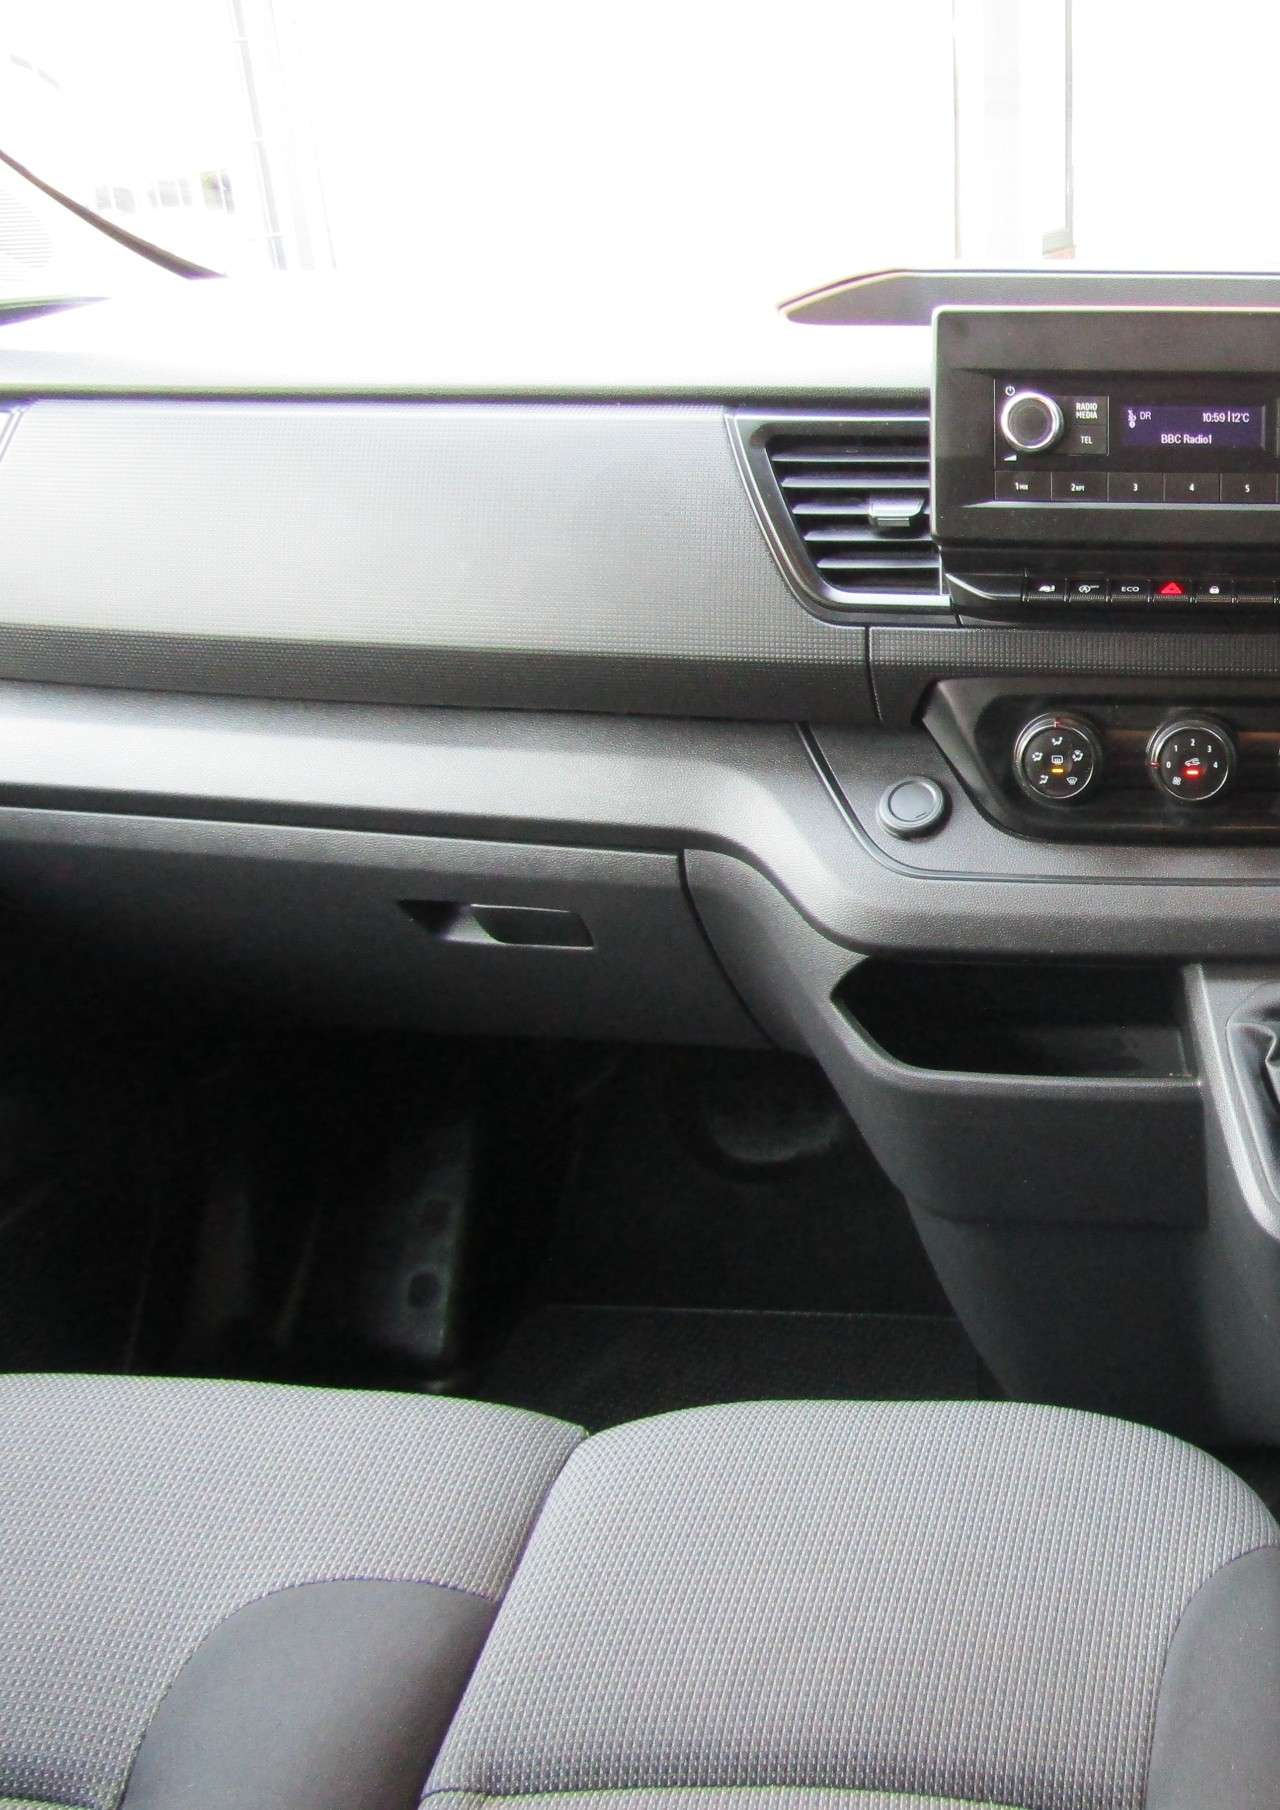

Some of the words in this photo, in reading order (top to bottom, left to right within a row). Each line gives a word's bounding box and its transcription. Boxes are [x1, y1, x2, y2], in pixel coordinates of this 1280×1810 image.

[1075, 402, 1098, 410] RADIO
[1075, 411, 1098, 419] MEDIA
[1202, 412, 1225, 422] 10:59
[1080, 436, 1092, 444] TEL
[1160, 434, 1182, 444] BBC
[1132, 483, 1138, 492] 3
[1188, 483, 1194, 492] 4
[1244, 484, 1250, 492] 5
[1190, 738, 1196, 747] 2
[1174, 744, 1178, 752] 1
[1208, 744, 1212, 752] 3
[1166, 761, 1172, 769] 0
[1212, 761, 1218, 769] 4
